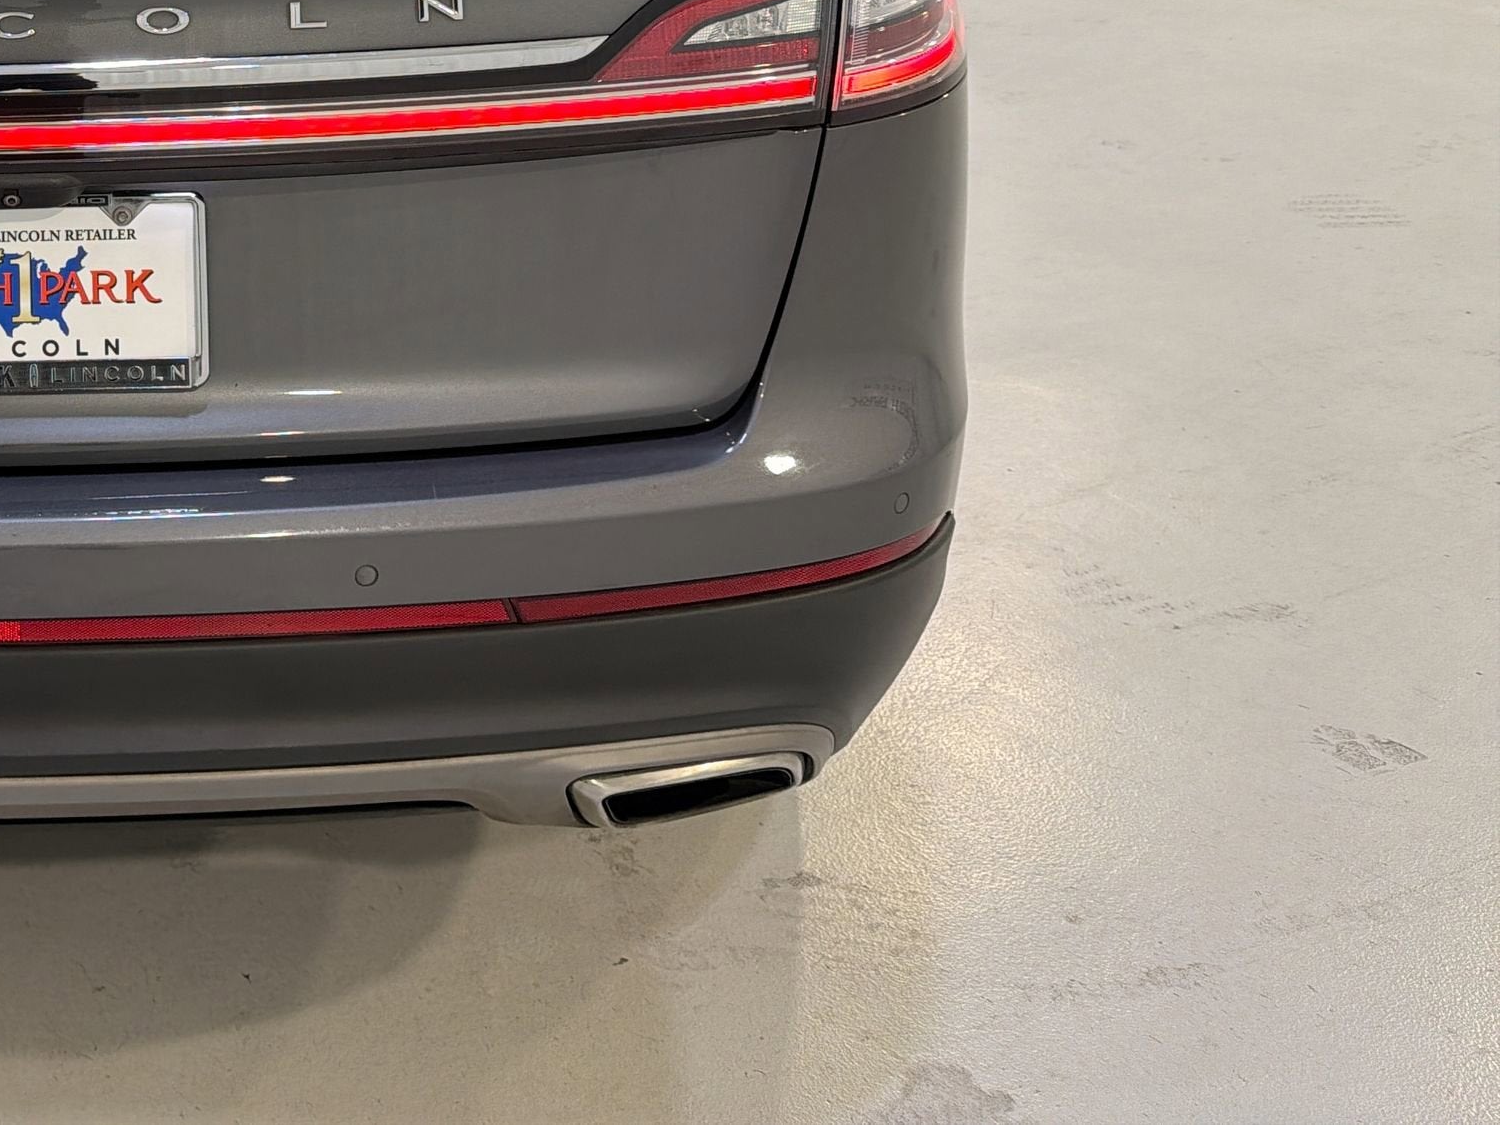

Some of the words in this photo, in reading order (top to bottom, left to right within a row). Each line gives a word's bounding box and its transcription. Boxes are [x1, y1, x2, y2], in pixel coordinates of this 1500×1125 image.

[64, 228, 138, 242] RETAILER
[38, 268, 163, 305] PARK
[50, 363, 187, 384] LINCOLN
